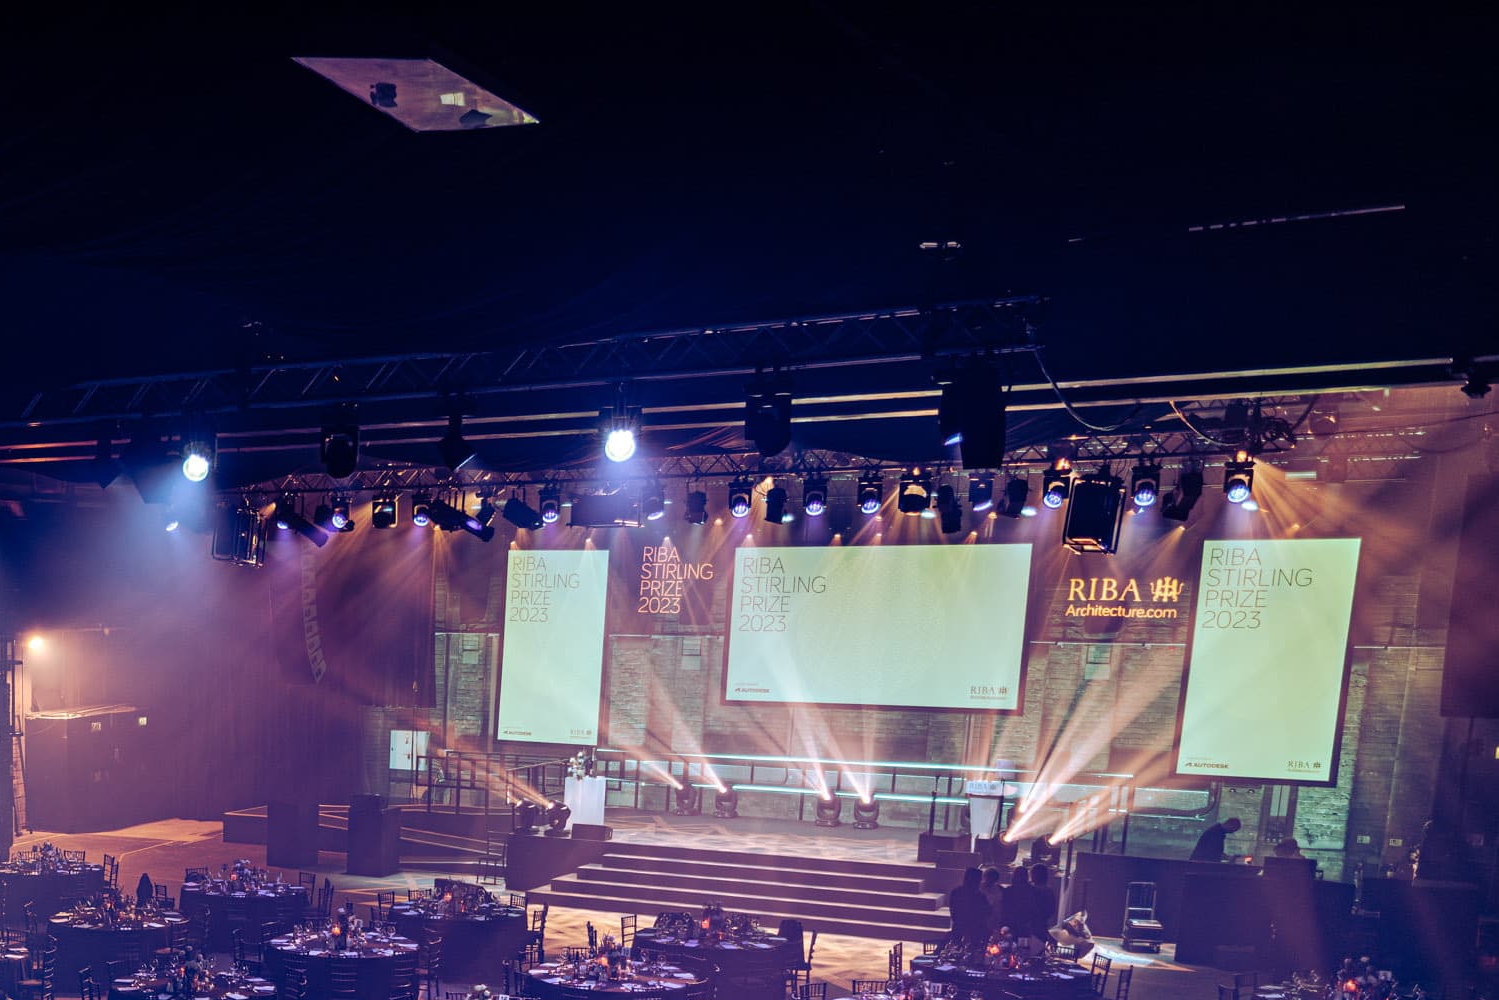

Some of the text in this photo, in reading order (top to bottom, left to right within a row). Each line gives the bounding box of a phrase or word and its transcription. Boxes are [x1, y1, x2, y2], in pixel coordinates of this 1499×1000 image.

[643, 546, 681, 562] RIBA
[1209, 547, 1262, 566] RIBA
[512, 556, 548, 571] RIBA
[640, 563, 714, 580] STIRLING
[743, 557, 785, 574] RIBA
[511, 573, 581, 589] STIRLING
[741, 576, 827, 593] STIRLING
[1206, 568, 1313, 587] STIRLING
[639, 580, 684, 597] PRIZE
[1067, 577, 1142, 602] RIBA
[510, 590, 552, 606] PRIZE
[637, 596, 681, 614] 2023
[740, 595, 791, 613] PRIZE
[1205, 589, 1269, 608] PRIZE
[509, 606, 549, 623] 2023
[1065, 603, 1177, 619] Architecture.com
[1201, 610, 1261, 629] 2023
[739, 614, 786, 632] 2023
[970, 686, 995, 695] RIBA
[1288, 760, 1310, 769] RIBA
